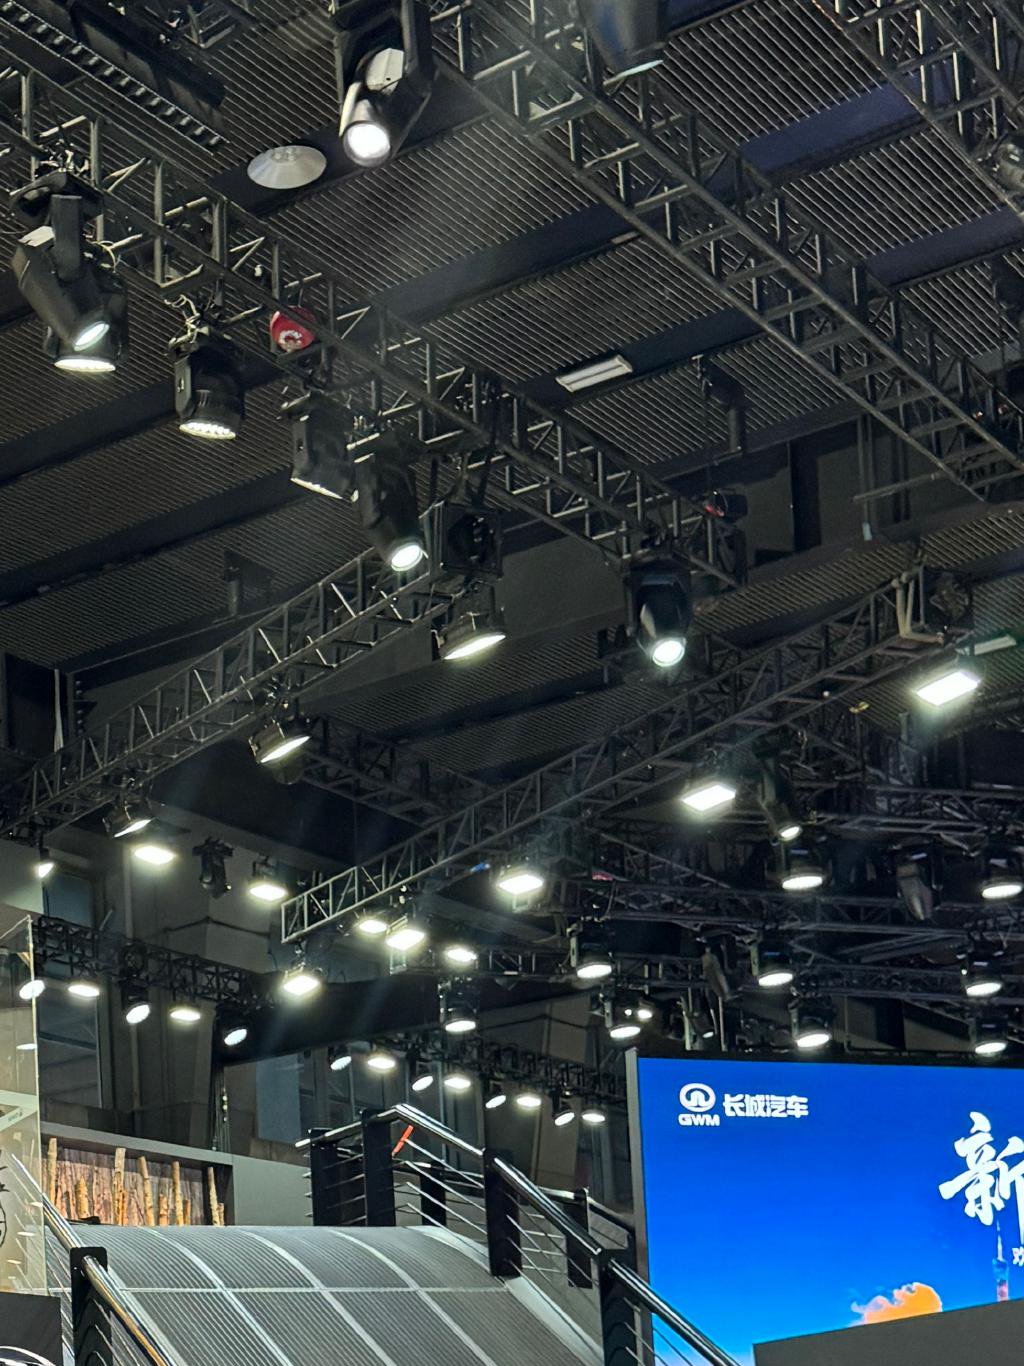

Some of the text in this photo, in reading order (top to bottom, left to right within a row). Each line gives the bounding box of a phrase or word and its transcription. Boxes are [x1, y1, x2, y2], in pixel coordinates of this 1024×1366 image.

[723, 1094, 809, 1118] 长城汽车
[678, 1113, 720, 1126] GWM
